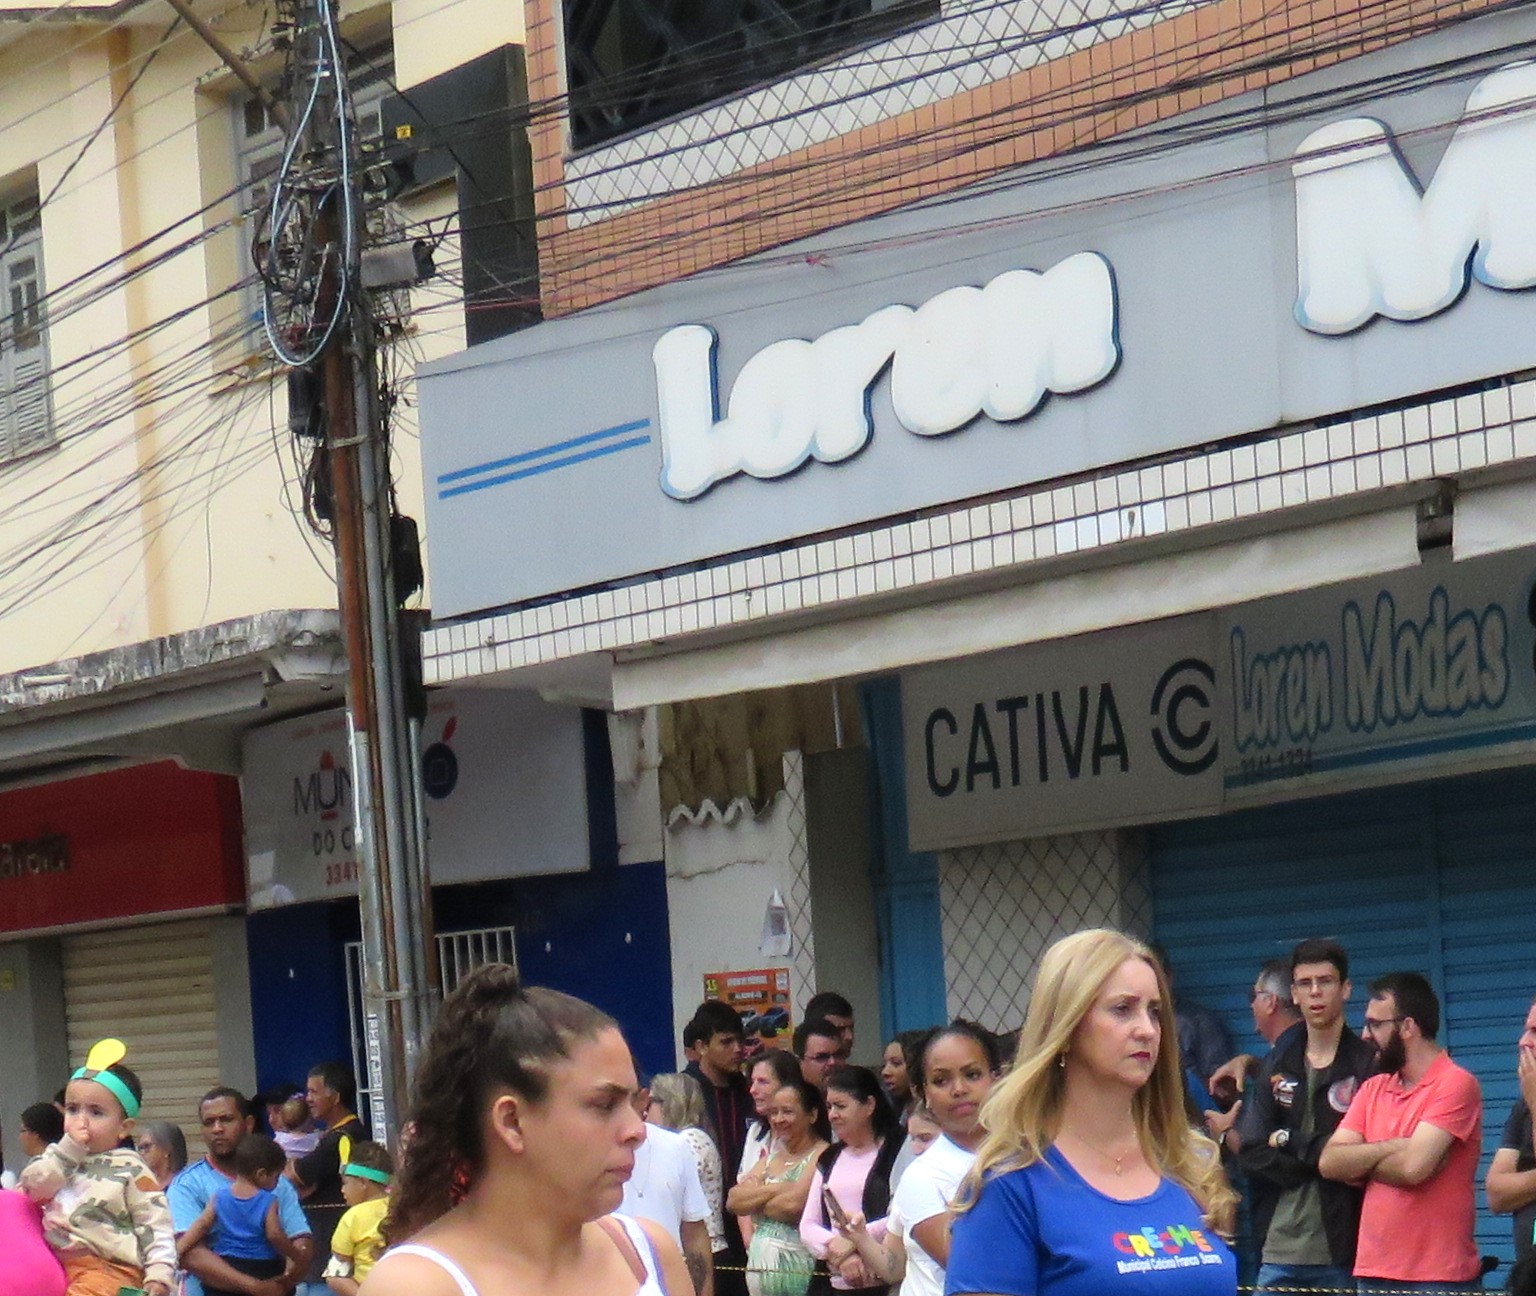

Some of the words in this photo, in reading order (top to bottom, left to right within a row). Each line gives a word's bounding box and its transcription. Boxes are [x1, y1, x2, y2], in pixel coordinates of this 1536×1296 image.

[653, 250, 1121, 501] Loren
[1230, 625, 1334, 754] Loren
[1341, 586, 1509, 733] Modas
[925, 682, 1130, 798] CATIVA
[1112, 1224, 1214, 1258] CRECHE
[1116, 1258, 1152, 1275] Municipal
